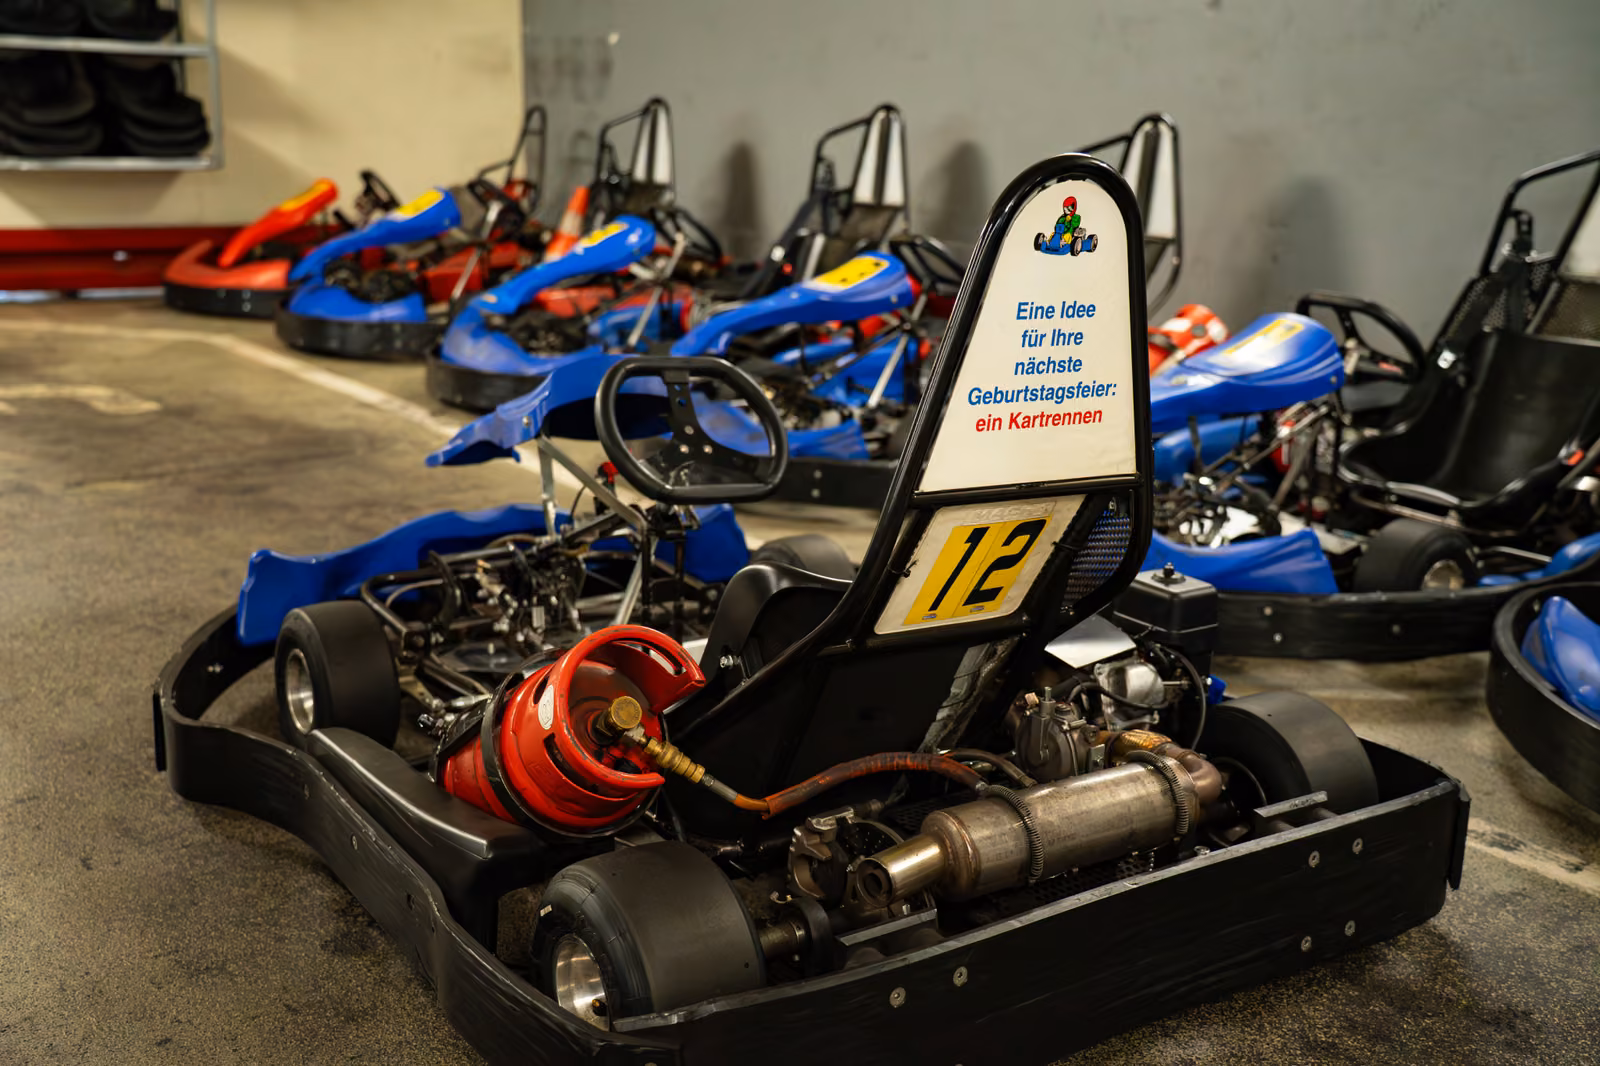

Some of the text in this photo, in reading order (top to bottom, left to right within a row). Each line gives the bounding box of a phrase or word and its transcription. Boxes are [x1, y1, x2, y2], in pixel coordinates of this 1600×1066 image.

[1016, 300, 1096, 320] Eine Idee
[1021, 328, 1084, 348] für Ihre
[1014, 356, 1083, 376] nächste
[967, 380, 1117, 406] Geburtstagsfeier:
[975, 409, 1103, 432] ein Kartrennen
[928, 519, 1047, 611] 12
